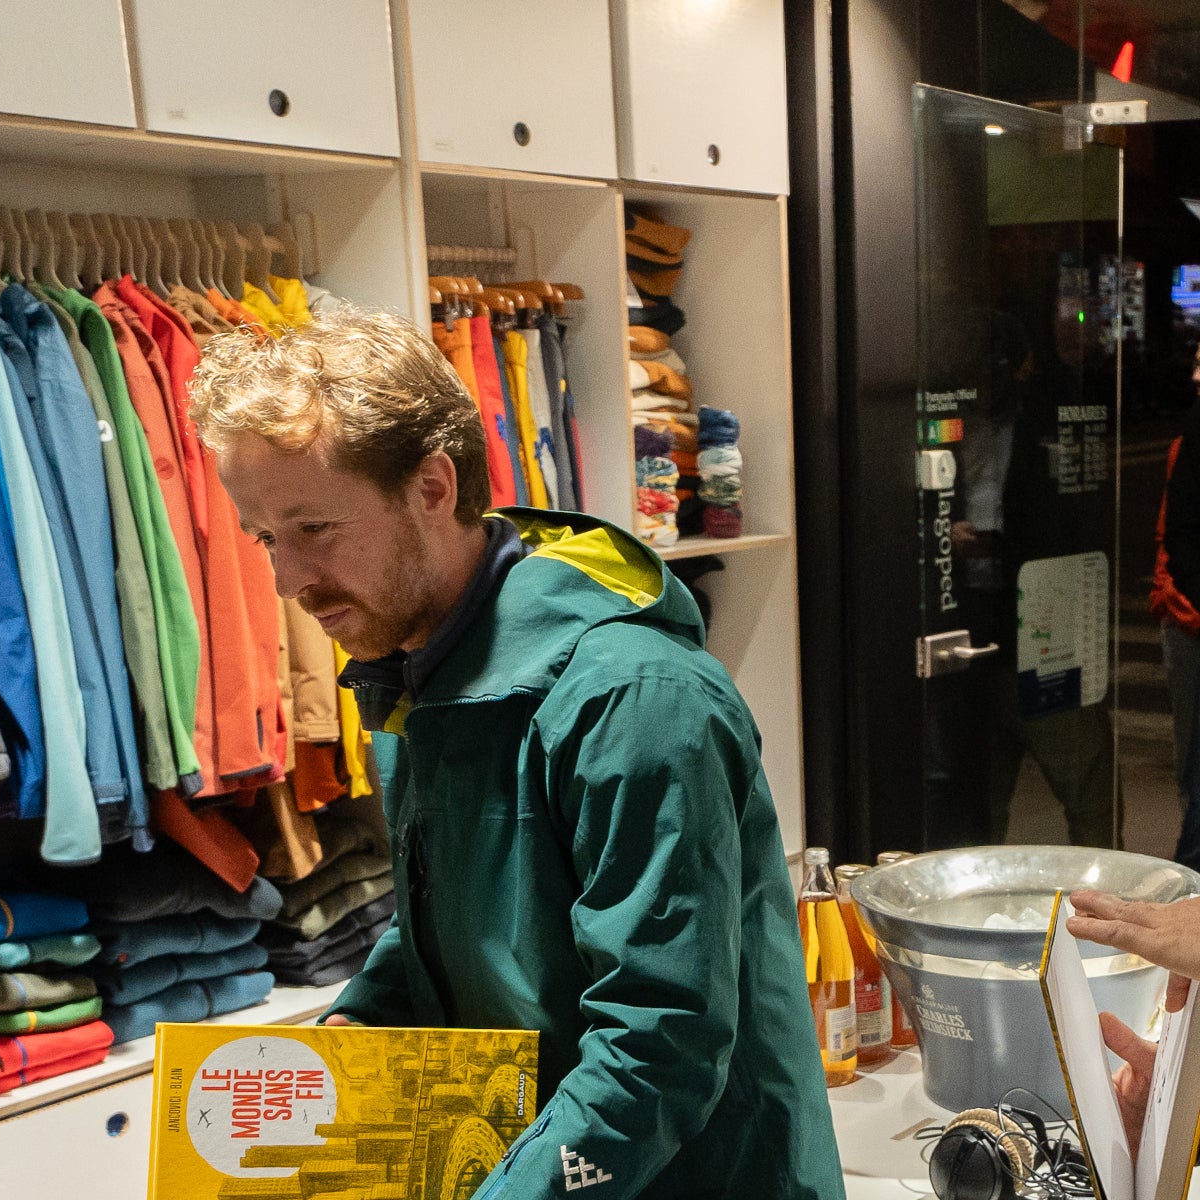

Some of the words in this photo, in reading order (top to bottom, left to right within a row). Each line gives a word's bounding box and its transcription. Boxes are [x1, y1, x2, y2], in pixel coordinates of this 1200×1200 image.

[170, 1067, 183, 1090] BLAIN
[201, 1068, 232, 1091] LE
[263, 1069, 295, 1121] SANS
[296, 1070, 324, 1100] FIN
[517, 1073, 526, 1117] DARGAUD
[167, 1095, 181, 1133] JANCOVICI
[231, 1068, 263, 1139] MONDE
